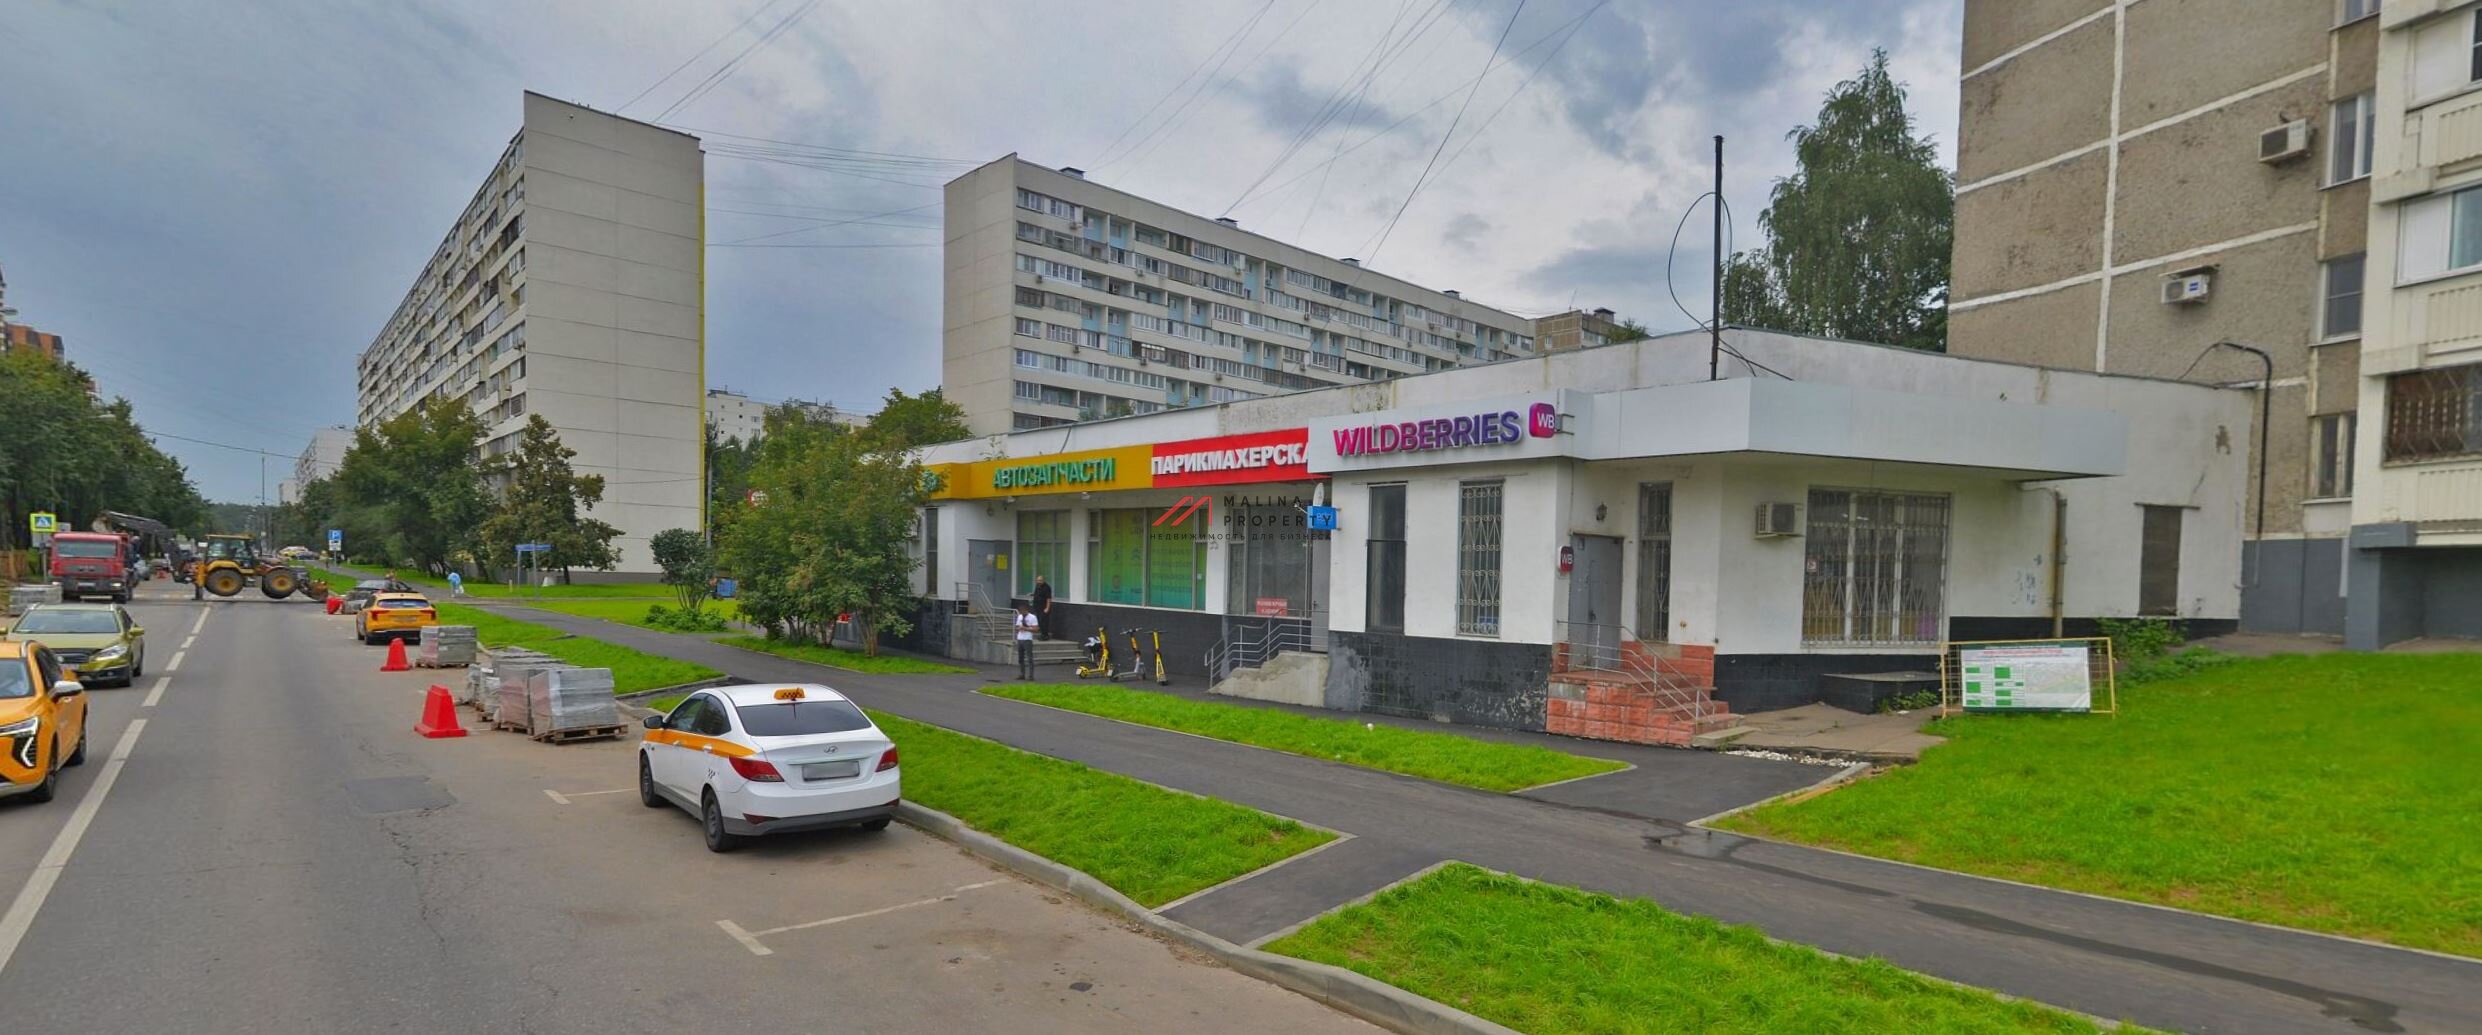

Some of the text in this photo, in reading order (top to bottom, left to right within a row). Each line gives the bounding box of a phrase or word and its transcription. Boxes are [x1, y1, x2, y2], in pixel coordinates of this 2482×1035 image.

[1333, 410, 1522, 457] WILDBERRIES
[1537, 411, 1555, 428] WB
[992, 456, 1116, 488] АВТОЗАПЧАСТИ
